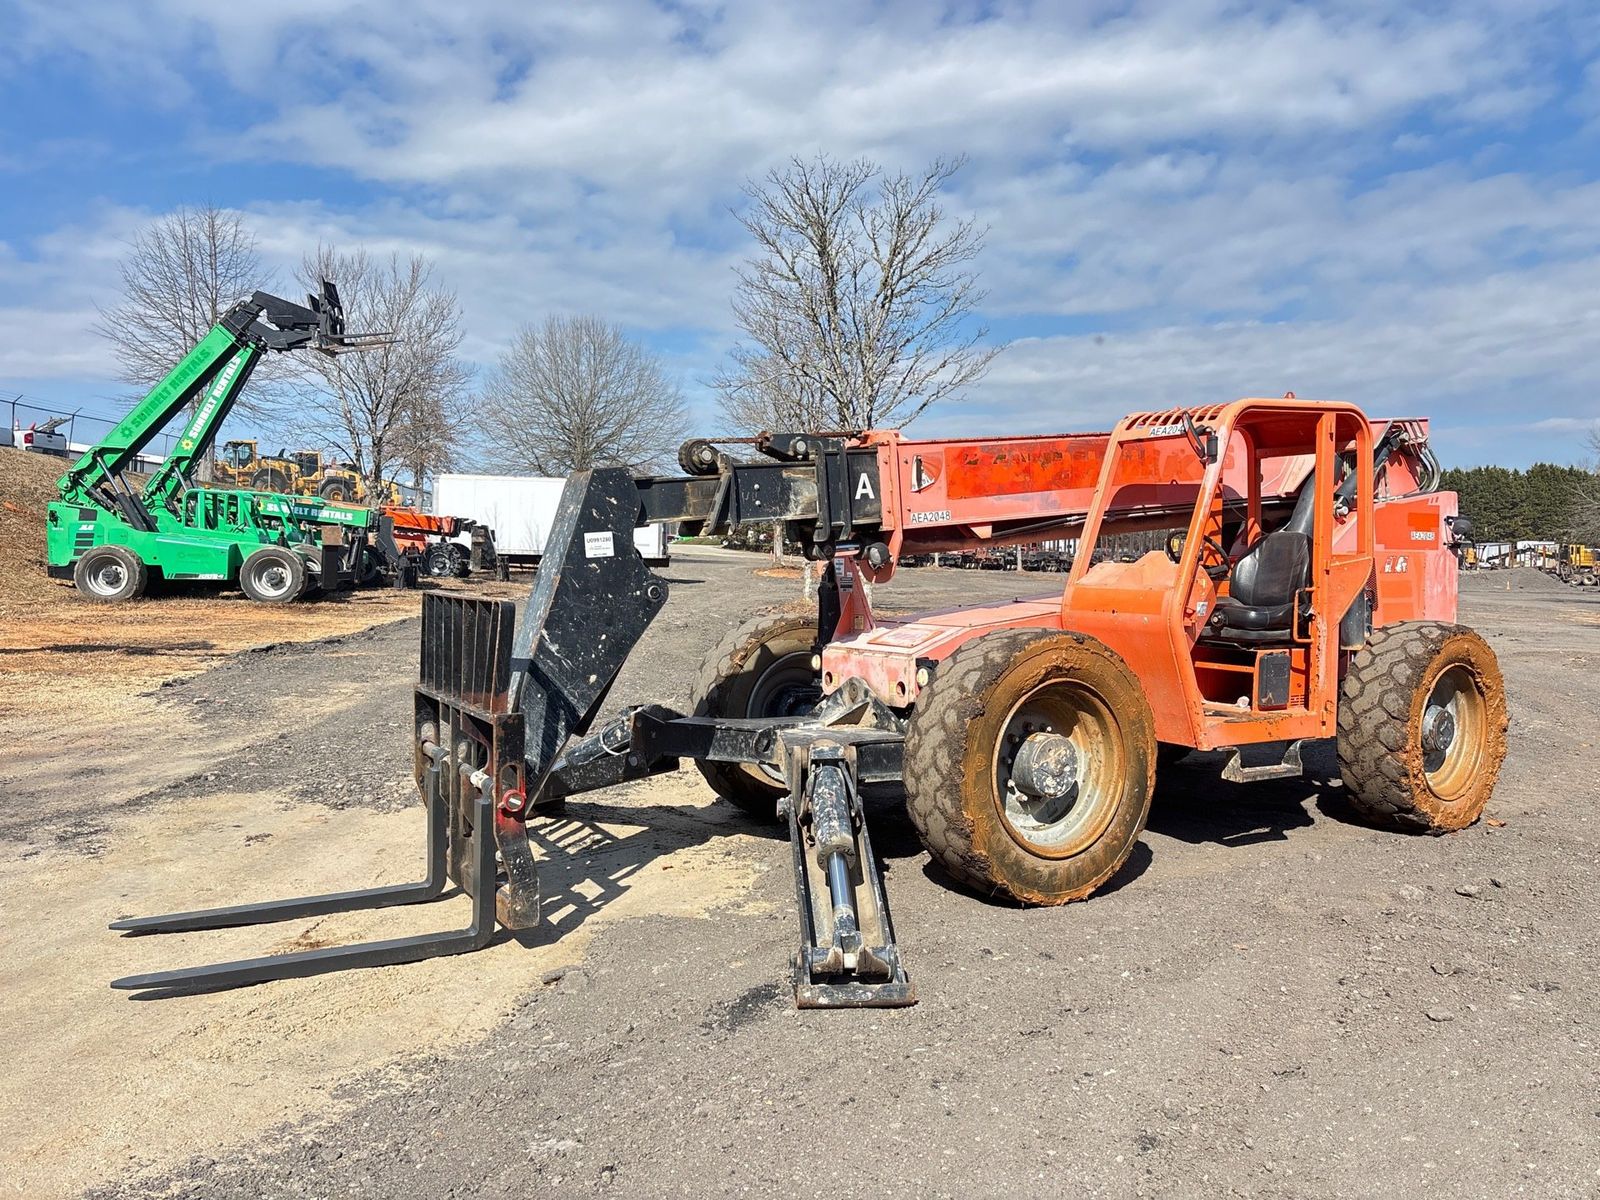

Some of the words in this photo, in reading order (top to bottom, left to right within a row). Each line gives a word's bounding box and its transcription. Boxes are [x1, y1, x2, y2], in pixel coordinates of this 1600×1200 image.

[169, 348, 212, 390] RENTALS
[189, 397, 217, 439] SUNBELT
[212, 355, 242, 398] RENTALS
[1150, 425, 1185, 436] AEA204
[855, 472, 875, 500] A
[311, 507, 353, 521] RENTALS
[911, 511, 951, 523] AEA2048
